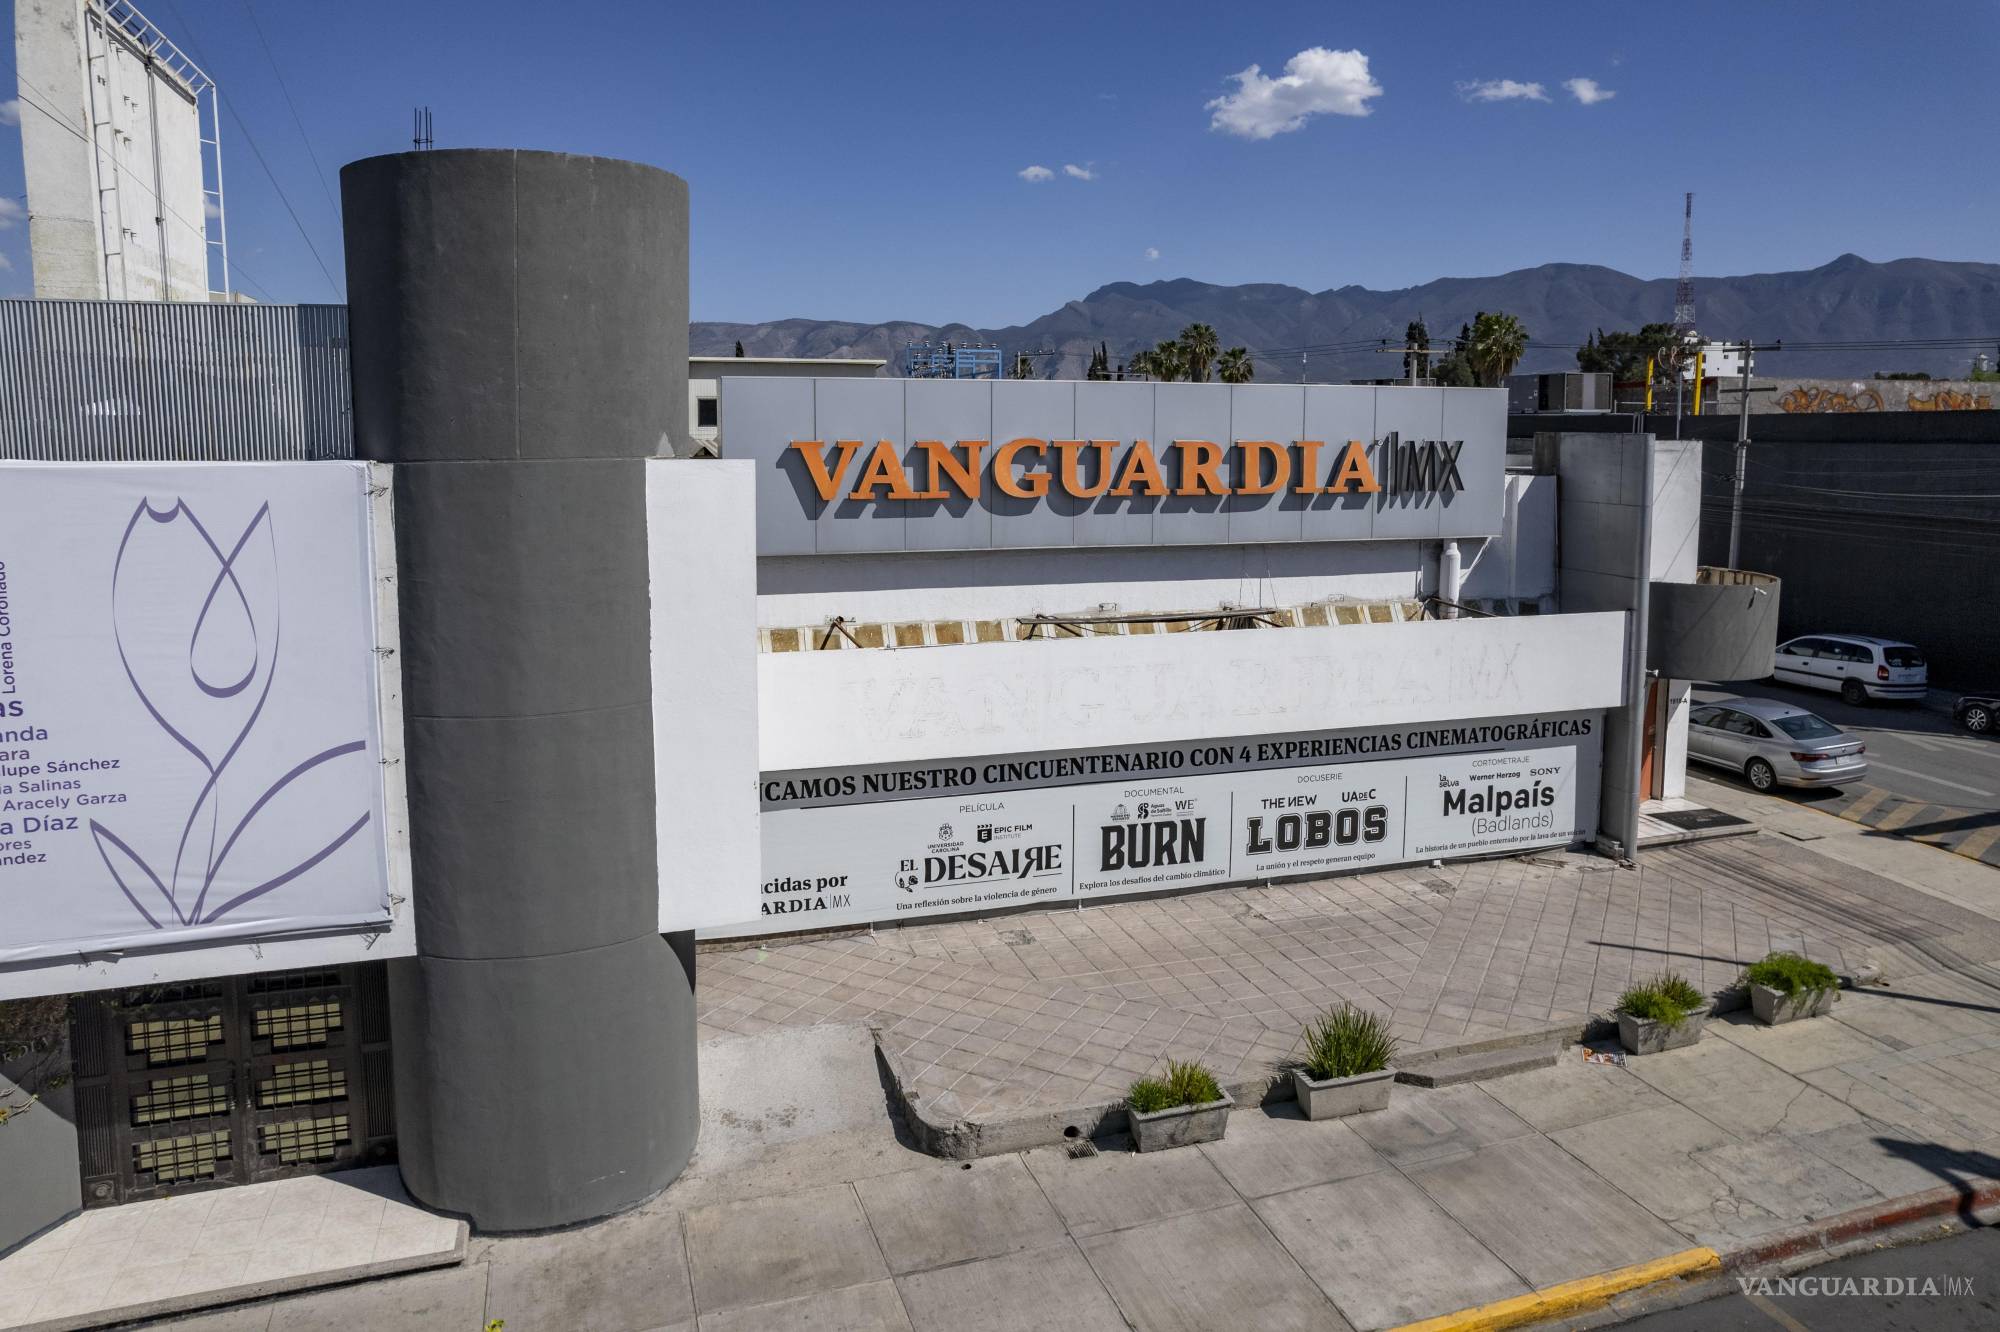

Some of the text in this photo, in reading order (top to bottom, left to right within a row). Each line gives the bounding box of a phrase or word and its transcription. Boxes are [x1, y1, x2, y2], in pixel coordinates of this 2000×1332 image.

[789, 438, 1382, 500] VANGUARDIA
[1, 641, 16, 694] Lorena
[0, 726, 48, 743] nda
[0, 750, 30, 762] ara
[862, 766, 978, 794] NUESTRO
[983, 750, 1184, 784] CINCUENTENARIO
[1190, 746, 1235, 767] CON
[1240, 745, 1252, 763] 4
[1257, 733, 1403, 762] EXPERIENCIAS
[1406, 718, 1592, 750] CINEMATOGRÁFICAS
[1471, 755, 1531, 767] CORTOMETRAJE
[0, 758, 120, 777] lupe Sánchez
[1530, 767, 1561, 776] SONY
[1297, 773, 1343, 784] DOCUSERIE
[1469, 771, 1521, 782] Werner Herzog
[19, 779, 81, 793] Salinas
[1124, 786, 1185, 798] DOCUMENTAL
[3, 793, 127, 811] Aracely Garza
[1175, 800, 1195, 810] WE
[1261, 797, 1285, 809] THE
[1443, 780, 1555, 817] Malpaís
[959, 802, 1005, 814] PELÍCULA
[24, 815, 79, 833] Díaz
[994, 824, 1033, 834] EPIC FILM
[1246, 805, 1389, 856] LOBOS
[1471, 810, 1554, 837] (Badlands)
[927, 841, 965, 850] UNIVERSIDAD
[931, 846, 960, 854] CAROLINA
[1100, 817, 1207, 872] BURN
[1415, 846, 1423, 854] La
[1425, 843, 1448, 853] historia
[1467, 839, 1489, 849] pueblo
[1489, 836, 1519, 846] enterrado
[1519, 835, 1529, 844] por
[1530, 833, 1536, 841] la
[1537, 832, 1549, 840] lava
[1550, 830, 1558, 838] de
[0, 852, 47, 866] ndez
[900, 859, 918, 872] EL
[1266, 859, 1286, 870] unión
[1292, 859, 1299, 867] el
[1300, 857, 1325, 868] respeto
[1325, 855, 1352, 865] generan
[1353, 852, 1376, 864] equipo
[816, 875, 848, 893] por
[1079, 880, 1108, 892] Explora
[1109, 879, 1121, 887] los
[1153, 874, 1165, 882] del
[1165, 872, 1192, 882] cambio
[1193, 868, 1226, 878] climático
[896, 886, 1058, 911] Una reflexión sobre la violencia de género
